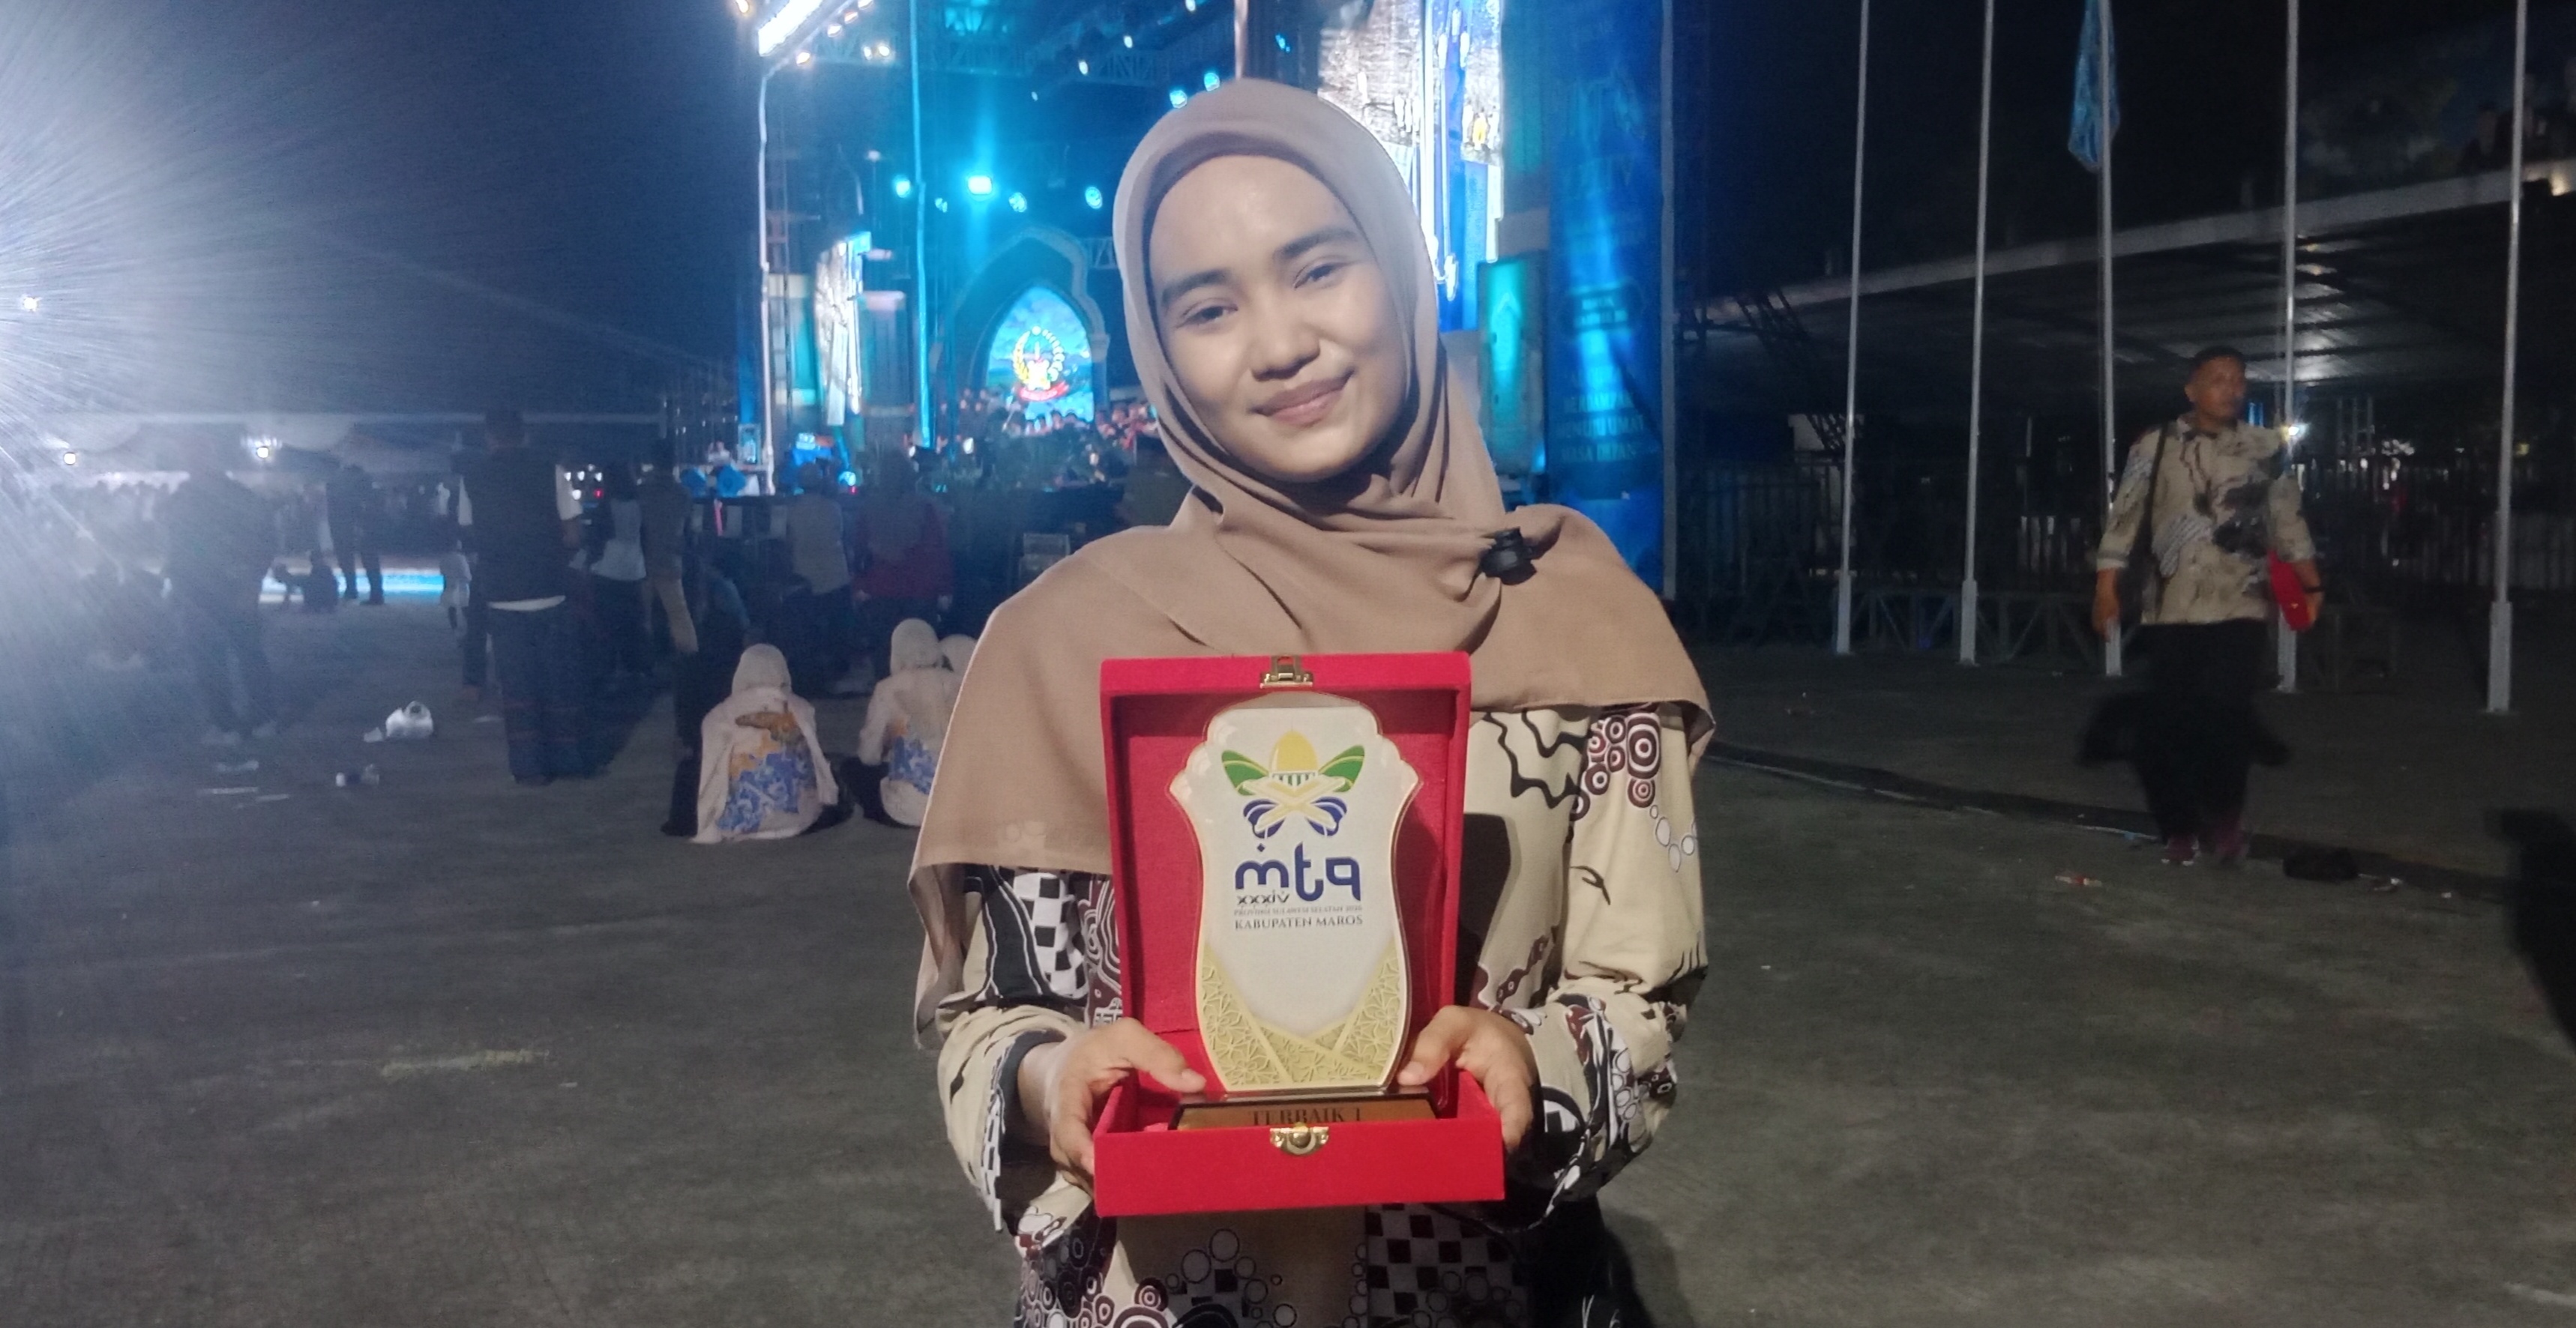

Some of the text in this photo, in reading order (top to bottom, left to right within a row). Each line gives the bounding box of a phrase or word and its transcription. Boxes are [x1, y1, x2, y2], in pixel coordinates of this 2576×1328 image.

[1235, 915, 1363, 930] KABUPATEN MAROS
[1249, 1108, 1343, 1126] TERBAIK
